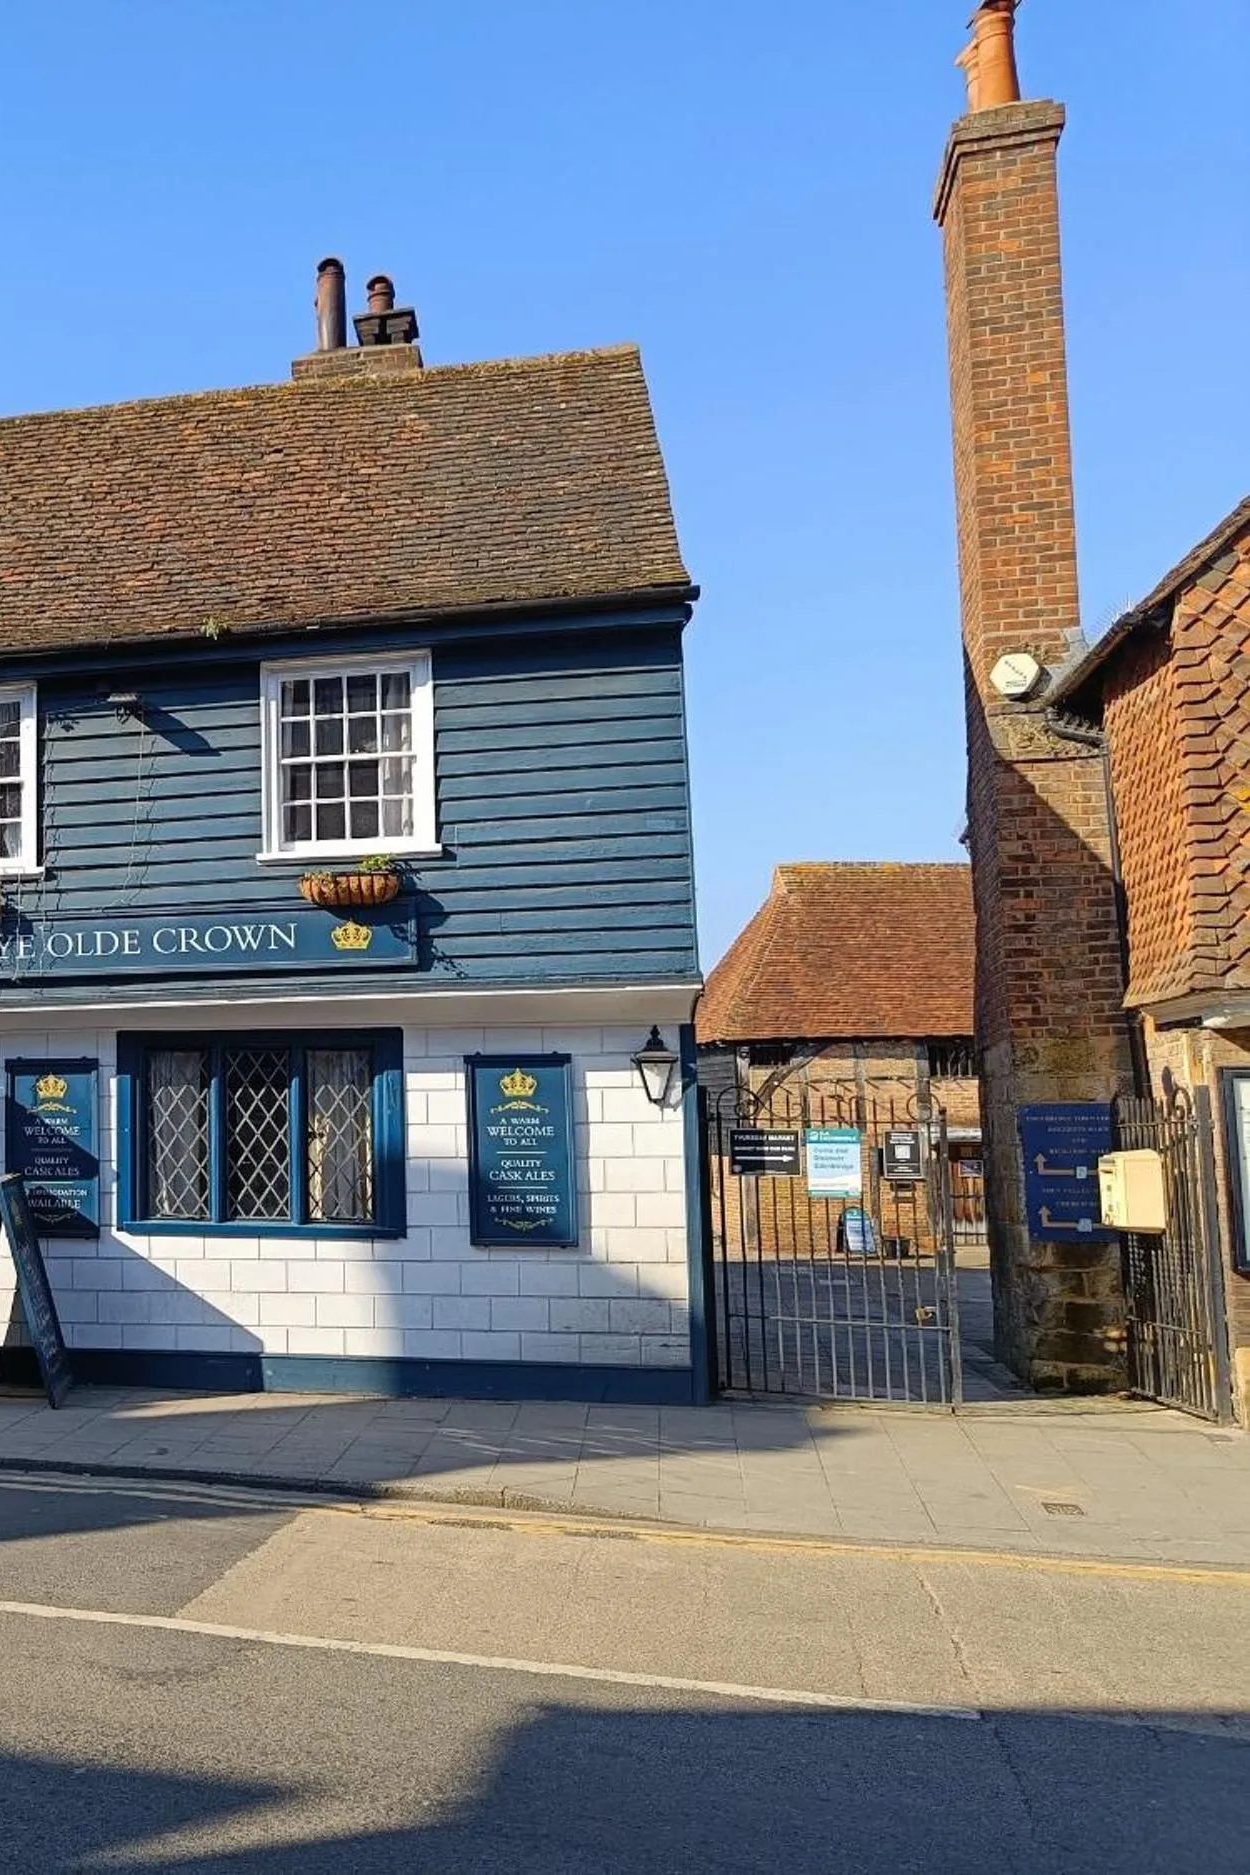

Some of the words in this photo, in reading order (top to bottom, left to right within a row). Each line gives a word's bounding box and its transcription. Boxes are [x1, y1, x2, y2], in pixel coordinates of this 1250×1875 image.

[46, 929, 141, 957] OLDE
[152, 923, 298, 954] CROWN
[500, 1117, 507, 1125] A
[510, 1117, 540, 1125] WARM
[24, 1126, 81, 1136] WELCOME
[487, 1126, 554, 1136] WELCOME
[503, 1138, 517, 1146] TO
[520, 1138, 538, 1146] ALL
[34, 1157, 69, 1165] QUALITY
[501, 1160, 542, 1168] QUALITY
[24, 1167, 53, 1176] CASK
[54, 1167, 79, 1176] ALES
[489, 1171, 522, 1180] CASK
[525, 1171, 555, 1181] ALES
[488, 1195, 524, 1203] LAGERS,
[526, 1194, 560, 1202] SPIRITS
[526, 1206, 557, 1214] WINES
